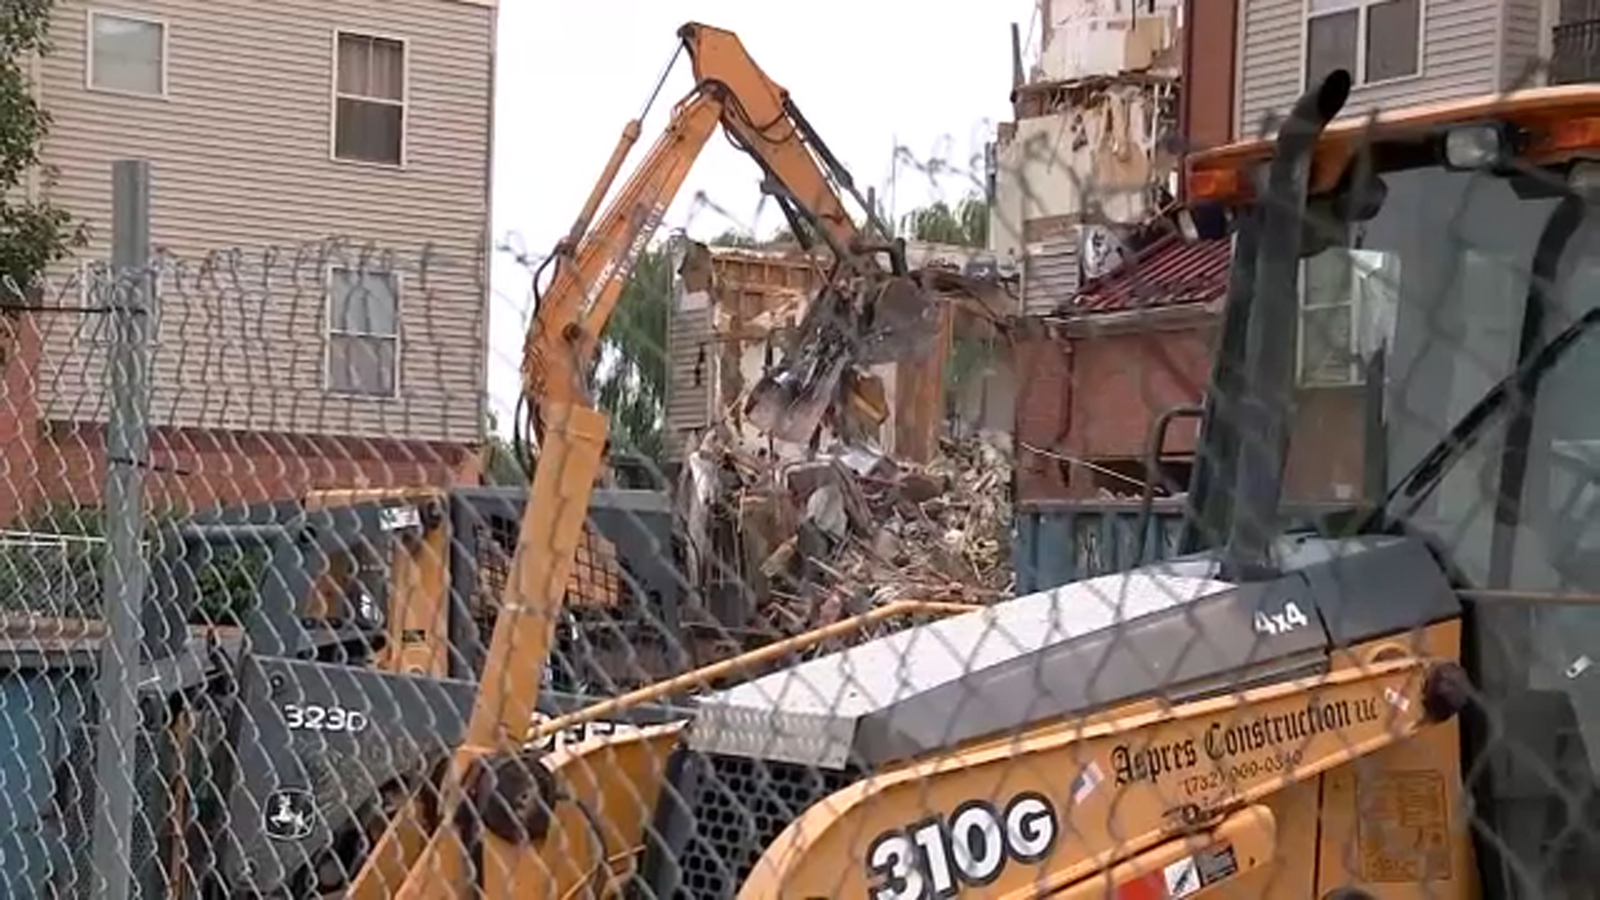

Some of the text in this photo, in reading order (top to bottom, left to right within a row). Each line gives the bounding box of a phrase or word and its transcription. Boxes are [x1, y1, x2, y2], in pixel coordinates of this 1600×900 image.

[1254, 602, 1308, 634] 4x4
[284, 704, 367, 732] 323D
[1204, 698, 1351, 761] Construction
[868, 793, 1057, 900] 310G
